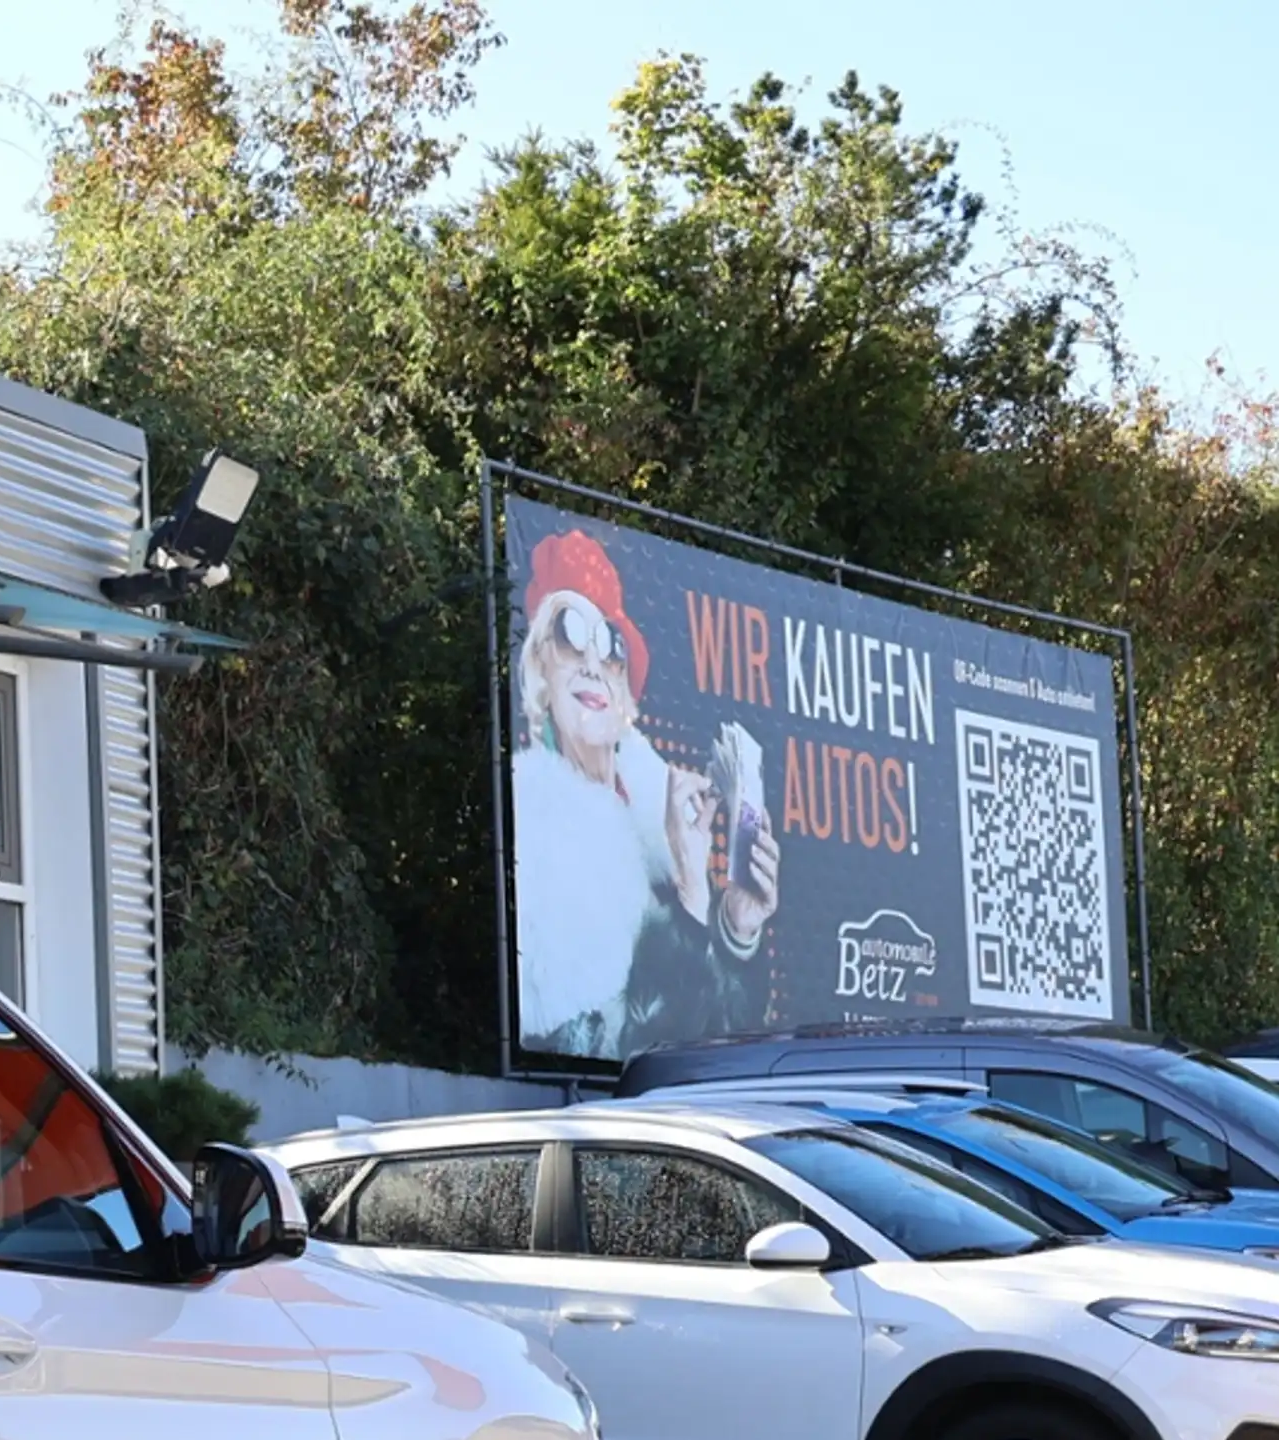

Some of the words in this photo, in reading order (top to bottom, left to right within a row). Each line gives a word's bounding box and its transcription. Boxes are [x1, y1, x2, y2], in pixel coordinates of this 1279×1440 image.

[685, 590, 772, 708] WIR
[783, 616, 935, 745] KAUFEN
[783, 735, 920, 856] AUTOS!
[835, 936, 907, 1002] Betz
